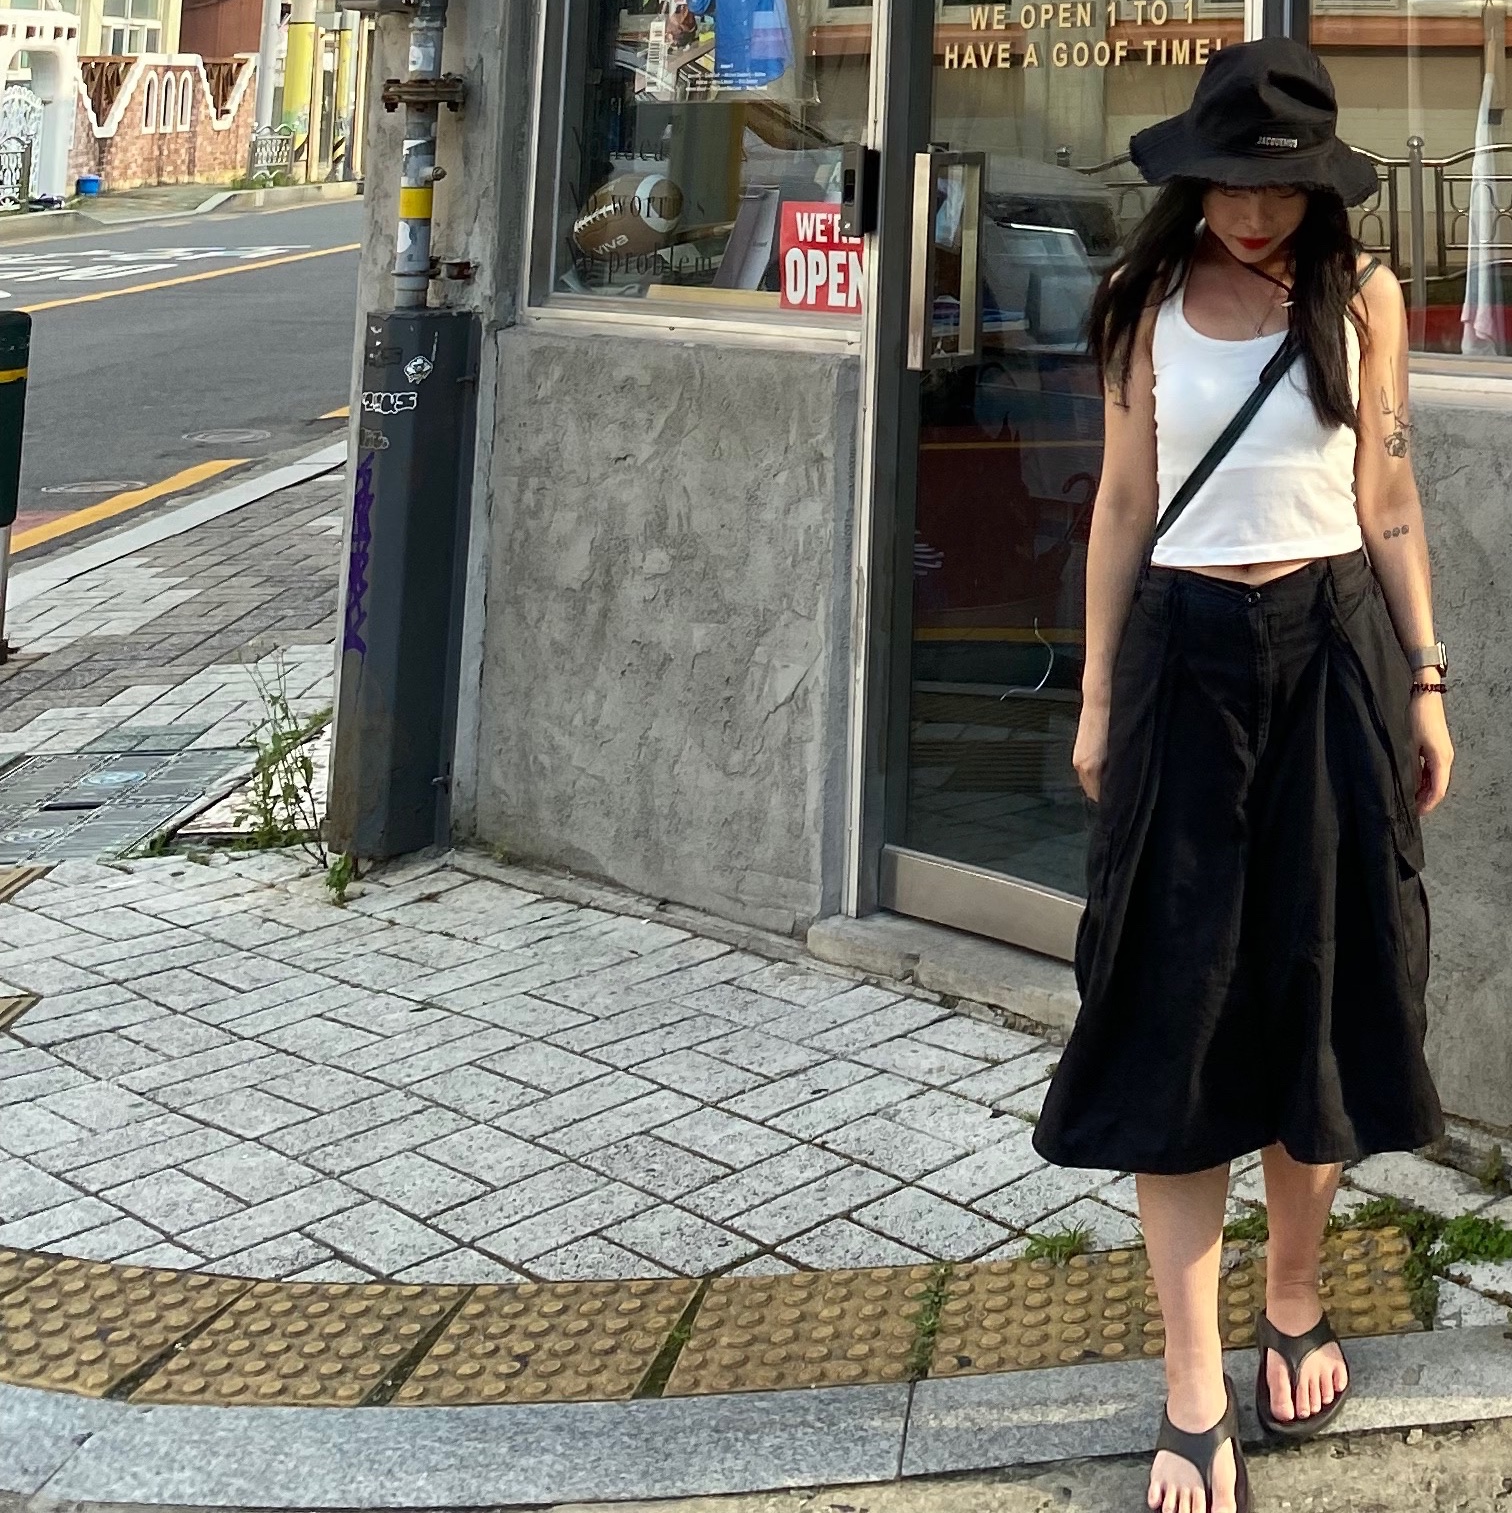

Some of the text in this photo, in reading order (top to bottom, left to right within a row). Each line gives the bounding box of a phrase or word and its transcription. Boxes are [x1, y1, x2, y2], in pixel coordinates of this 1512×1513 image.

[970, 4, 1007, 31] WE
[1020, 2, 1092, 29] OPEN
[1107, 1, 1118, 27] 1
[1134, 0, 1168, 25] TO
[944, 42, 1012, 70] HAVE
[1023, 43, 1039, 68] A
[1053, 40, 1129, 68] GOOF
[796, 212, 861, 245] WE'R
[784, 247, 864, 308] OPEN
